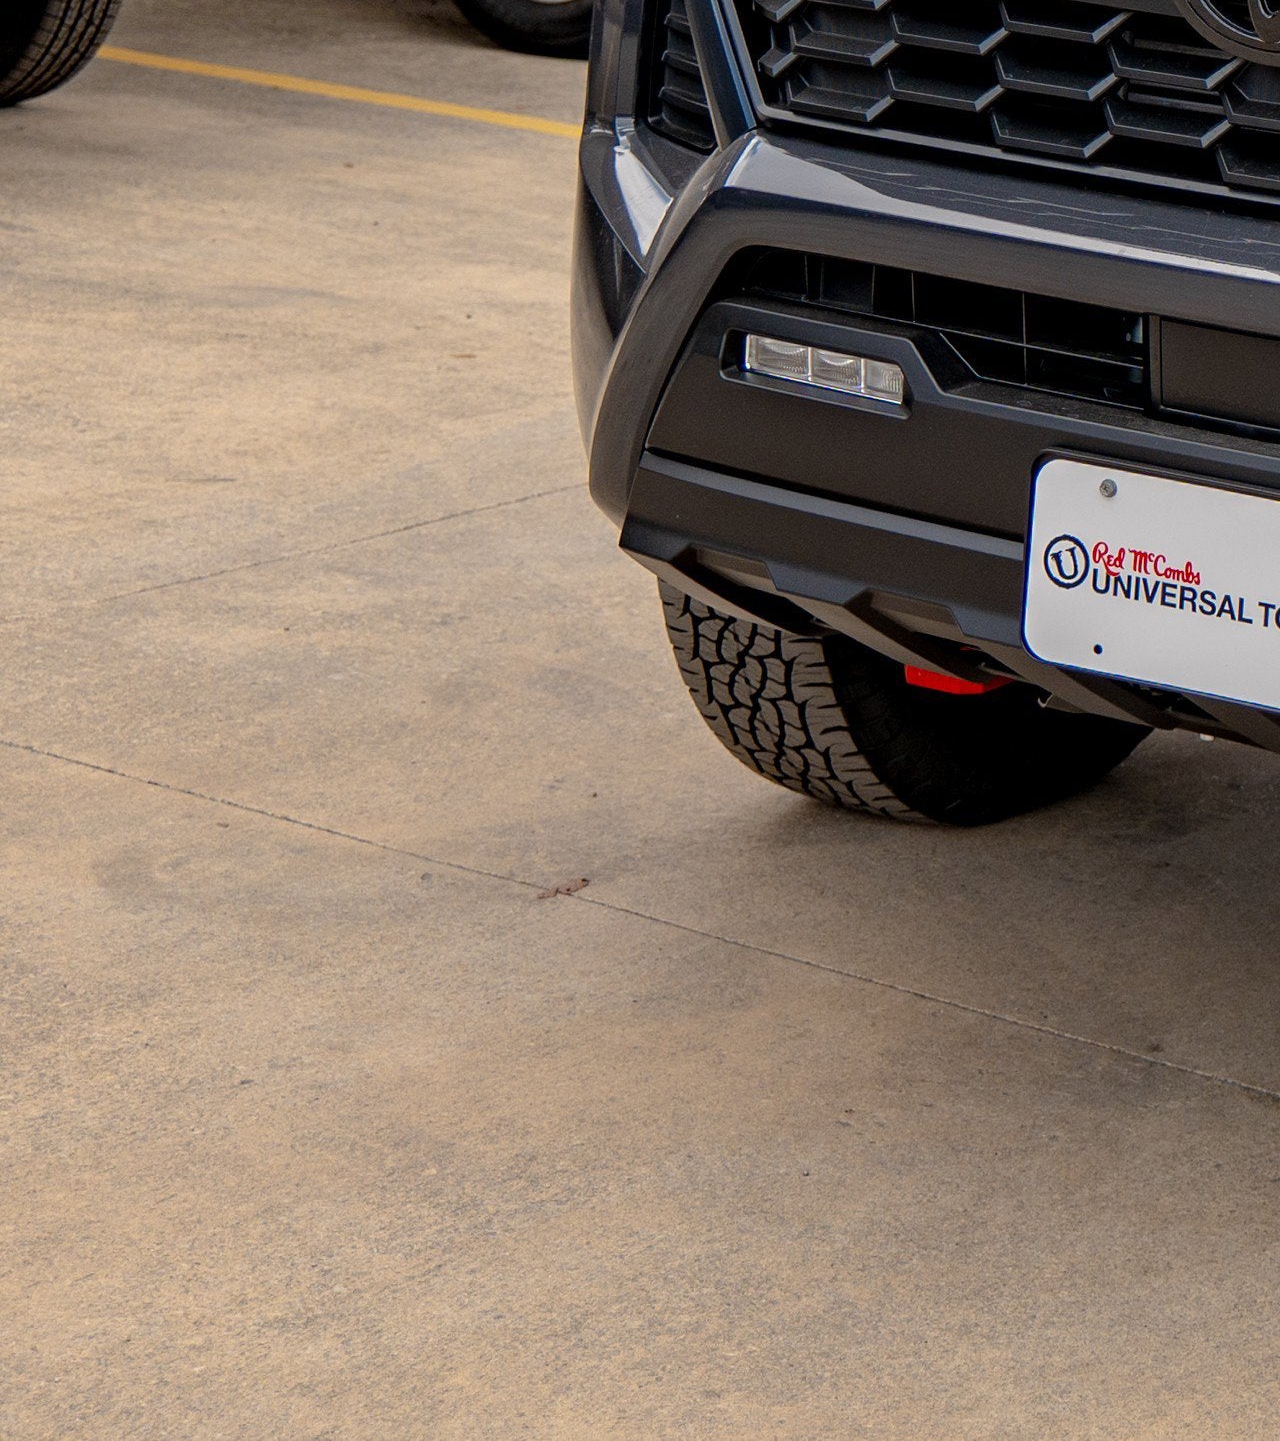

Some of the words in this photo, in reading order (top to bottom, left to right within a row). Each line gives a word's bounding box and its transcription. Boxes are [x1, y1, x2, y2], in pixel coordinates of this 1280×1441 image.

[1092, 541, 1125, 577] Red
[1128, 548, 1201, 585] McCombs
[1091, 568, 1254, 625] UNIVERSAL
